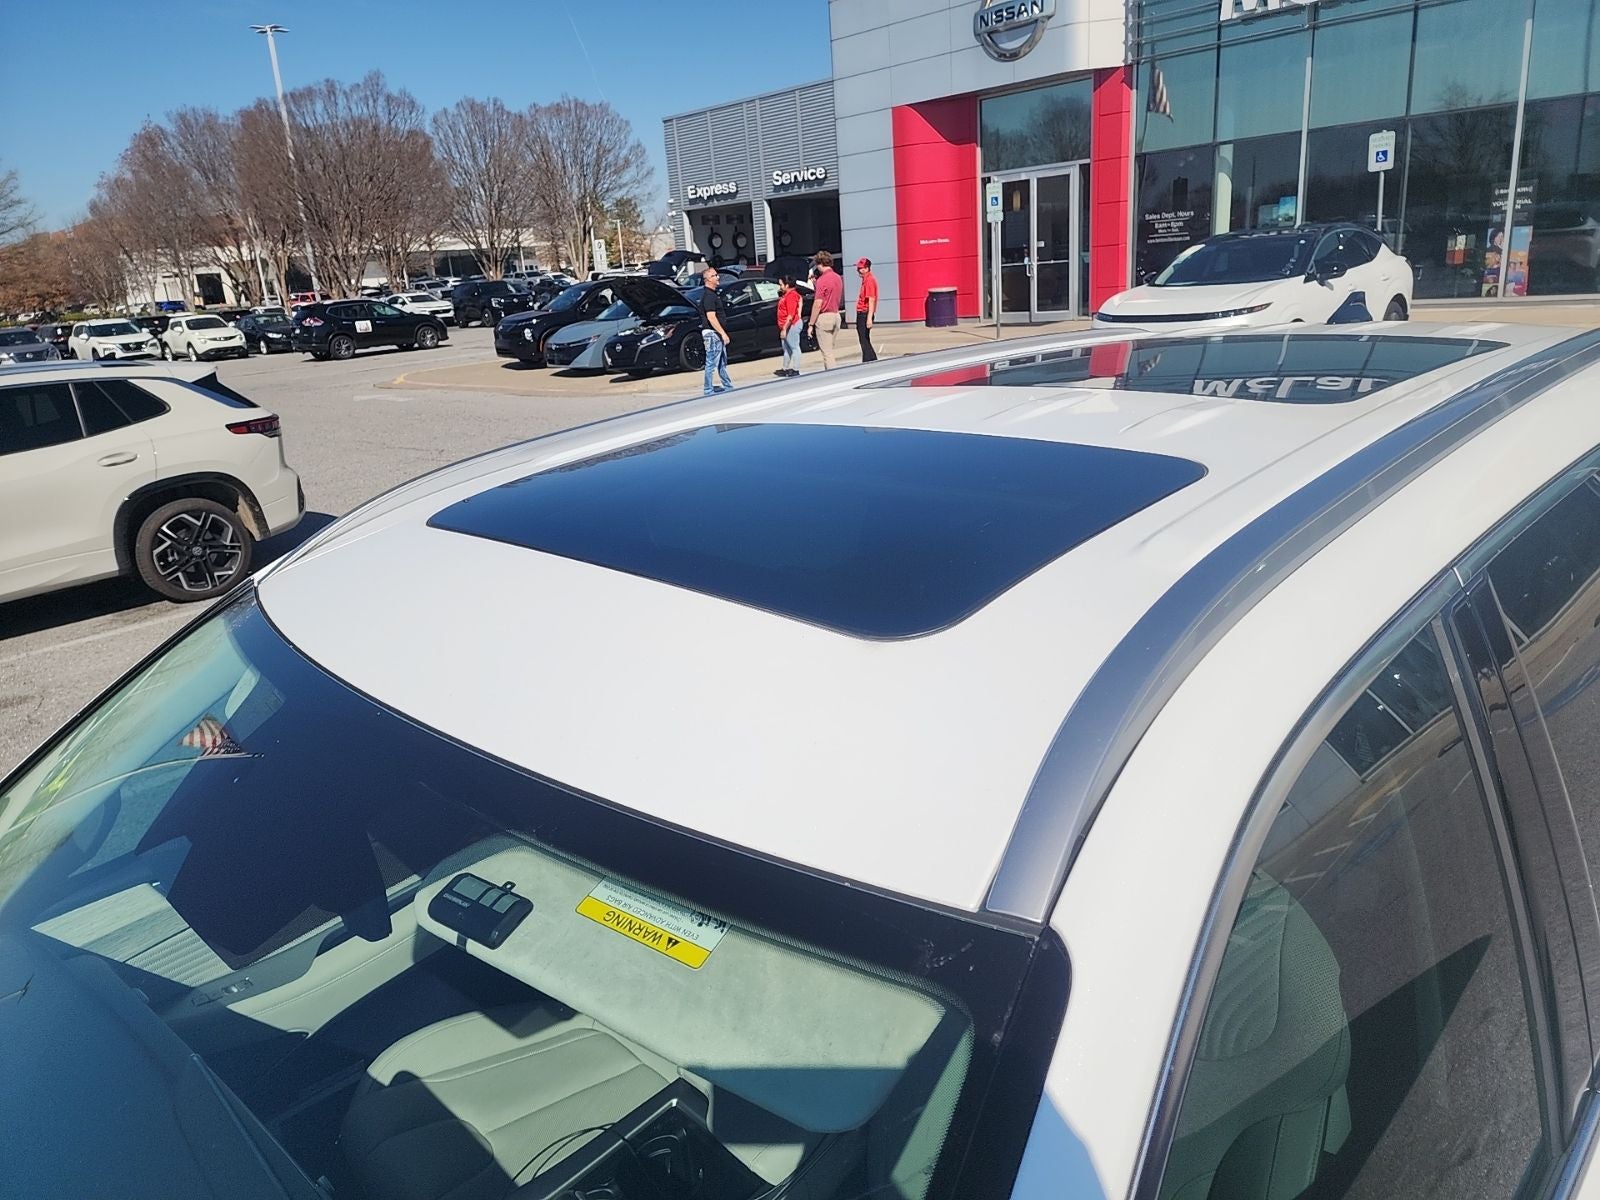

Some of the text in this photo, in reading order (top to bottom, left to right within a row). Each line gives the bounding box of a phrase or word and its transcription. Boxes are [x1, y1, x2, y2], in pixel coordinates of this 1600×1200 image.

[979, 0, 1044, 29] NISSAN
[687, 181, 737, 200] Express
[772, 166, 827, 186] Service
[603, 910, 664, 945] WARNING
[607, 894, 700, 940] EVEN WITH ADVANCED AIR BAGS
